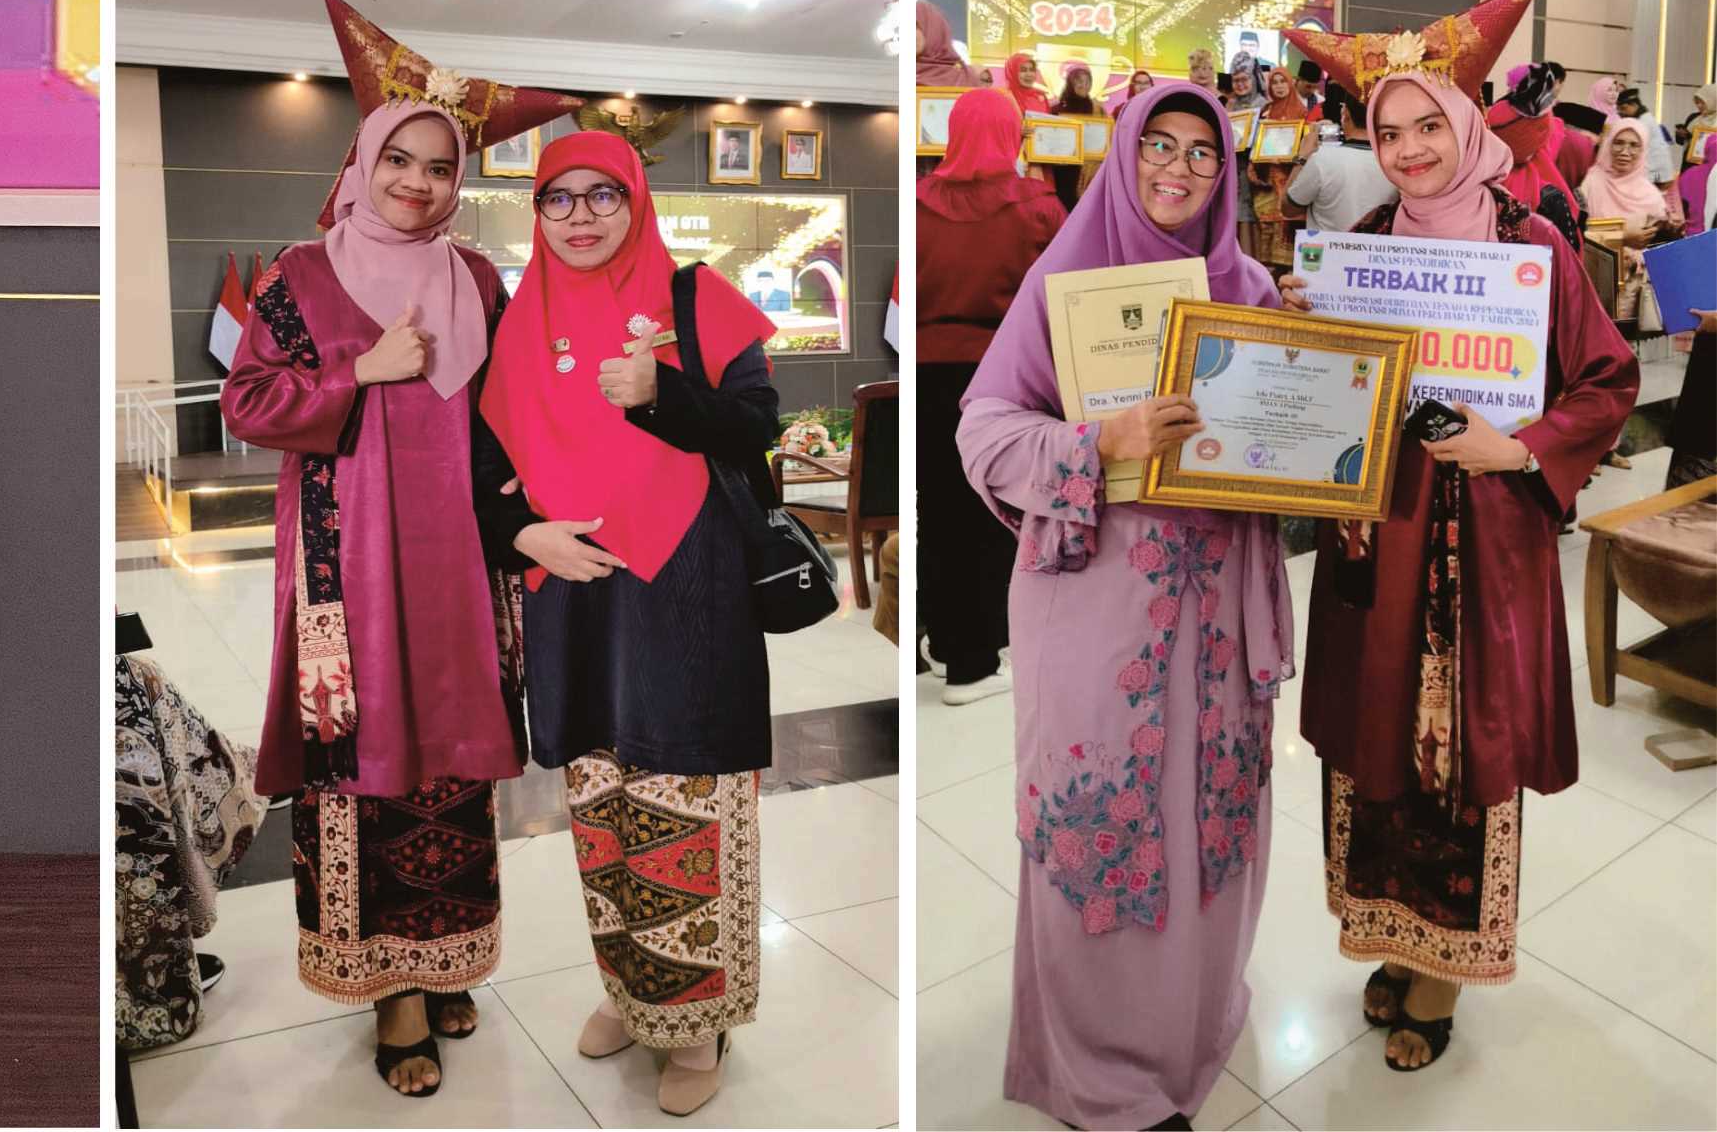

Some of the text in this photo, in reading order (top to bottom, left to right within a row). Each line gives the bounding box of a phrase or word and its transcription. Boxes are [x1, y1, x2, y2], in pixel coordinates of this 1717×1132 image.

[1034, 4, 1113, 34] 2024
[1344, 266, 1486, 296] TERBAIK III
[1090, 343, 1119, 353] DINAS
[1122, 338, 1158, 349] PENDID
[1113, 392, 1142, 405] Yenni
[1412, 385, 1535, 410] KEPENDIDIKAN SMA
